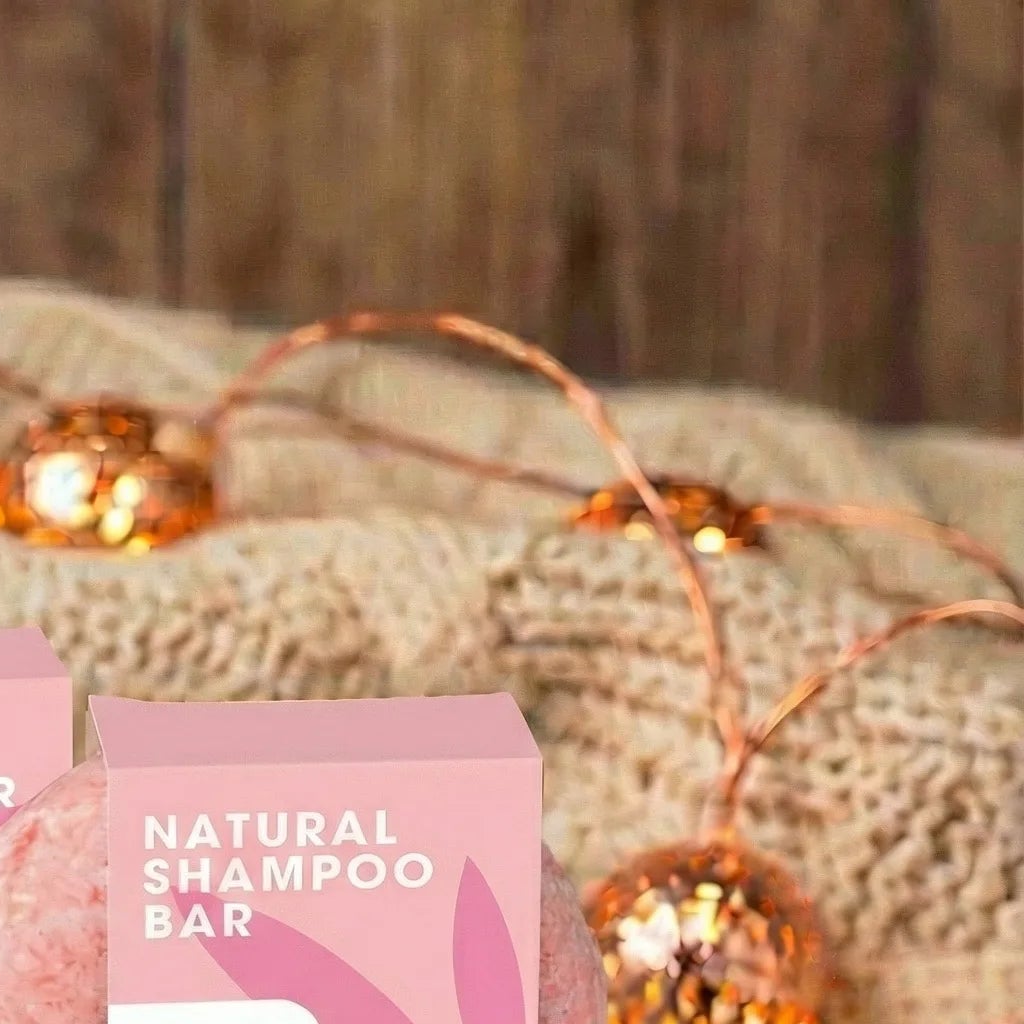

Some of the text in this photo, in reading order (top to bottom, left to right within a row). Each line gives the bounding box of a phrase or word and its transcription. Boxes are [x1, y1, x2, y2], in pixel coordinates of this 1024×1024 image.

[144, 809, 397, 849] NATURAL
[143, 852, 434, 895] SHAMPOO
[144, 902, 253, 939] BAR
